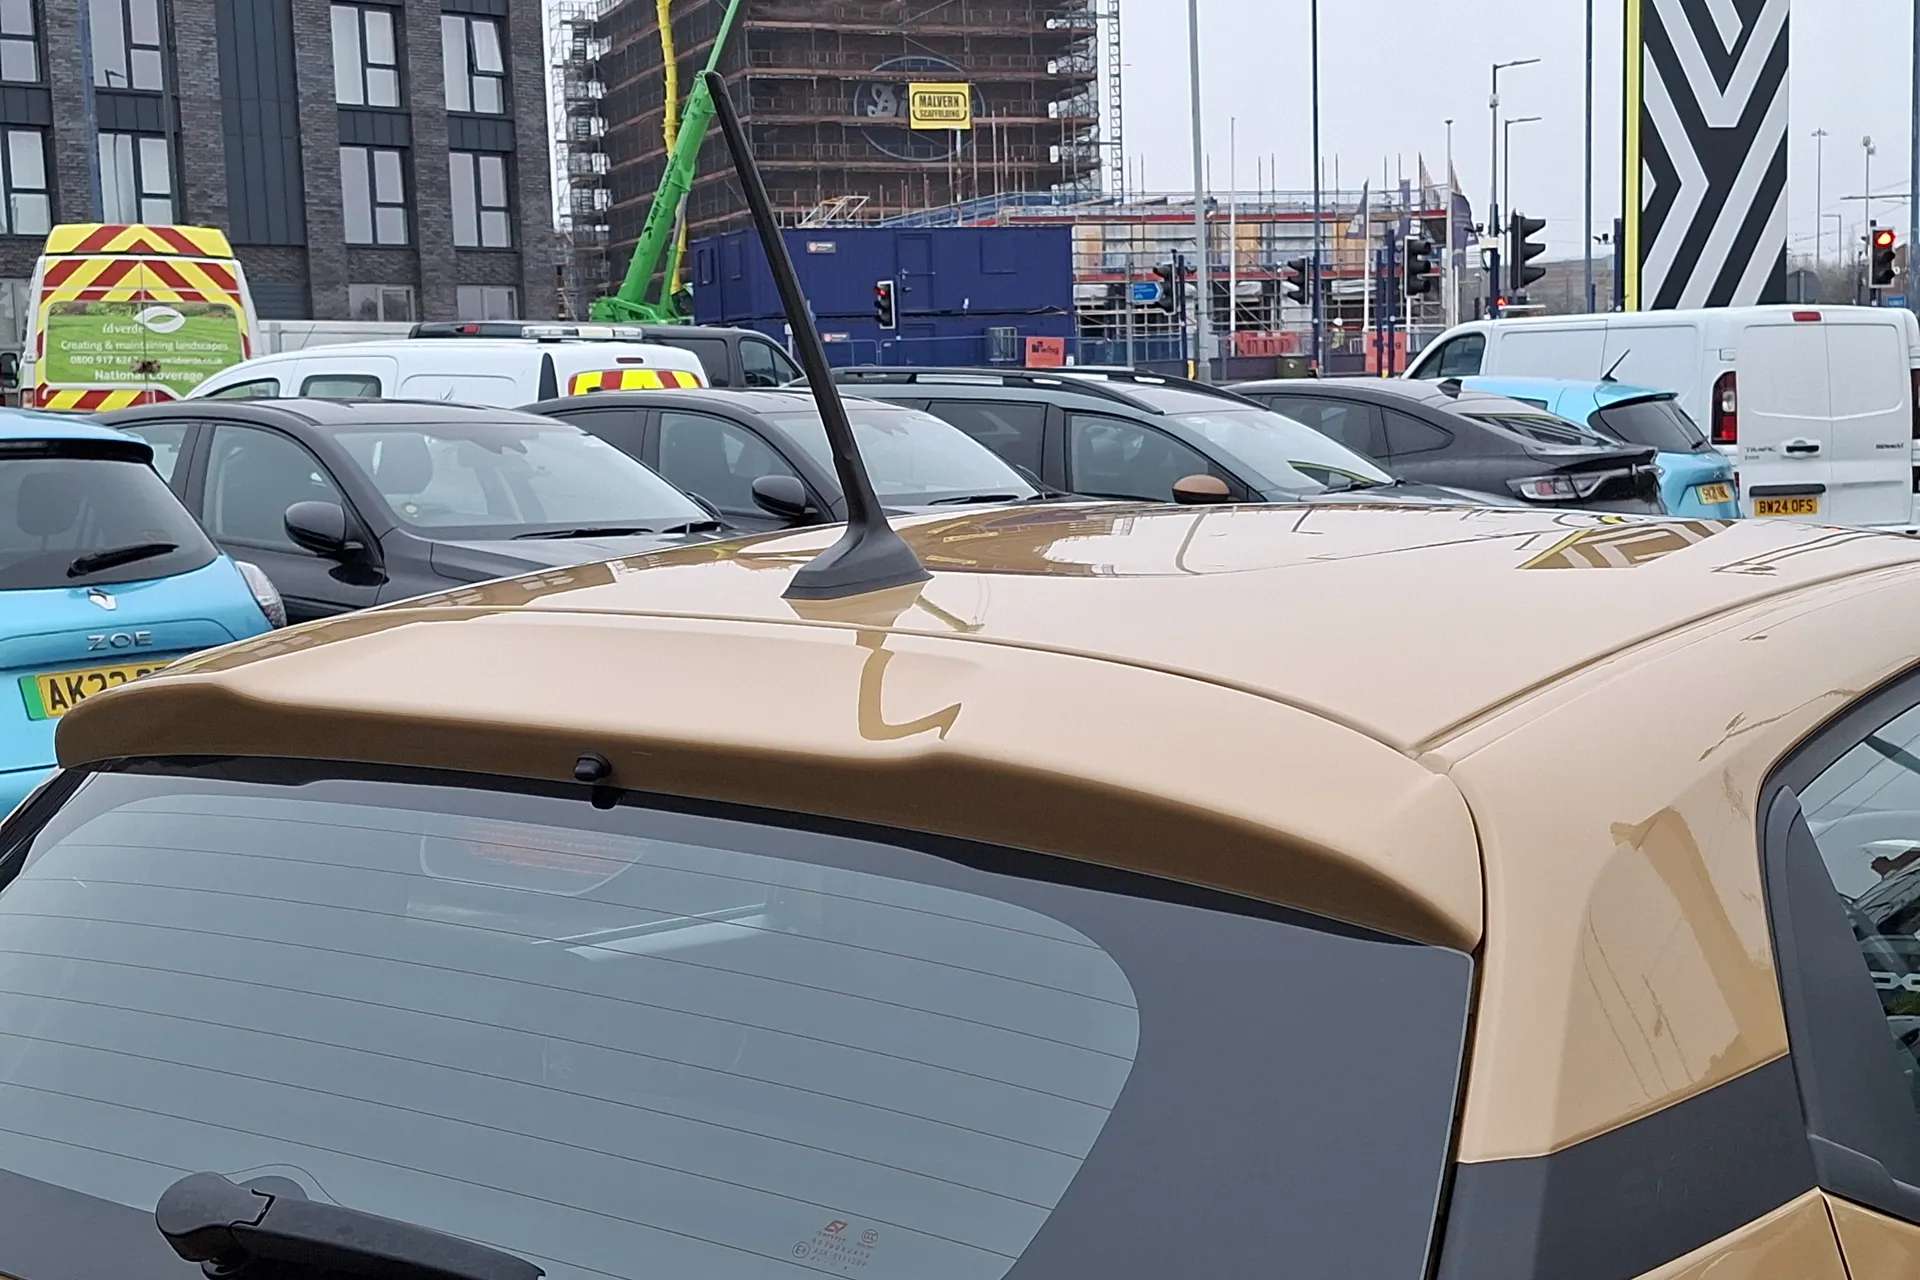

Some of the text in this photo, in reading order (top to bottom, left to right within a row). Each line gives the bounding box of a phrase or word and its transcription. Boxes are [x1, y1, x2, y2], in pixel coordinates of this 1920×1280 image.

[919, 95, 960, 108] MALVERN
[920, 109, 960, 118] SCAFFOLDING
[60, 340, 229, 353] Creating & maintaining landscapes
[70, 355, 94, 365] 0800
[96, 355, 114, 365] 917
[94, 369, 205, 384] National Coverage
[1759, 499, 1814, 514] BW24 OFS
[87, 630, 153, 651] ZOE
